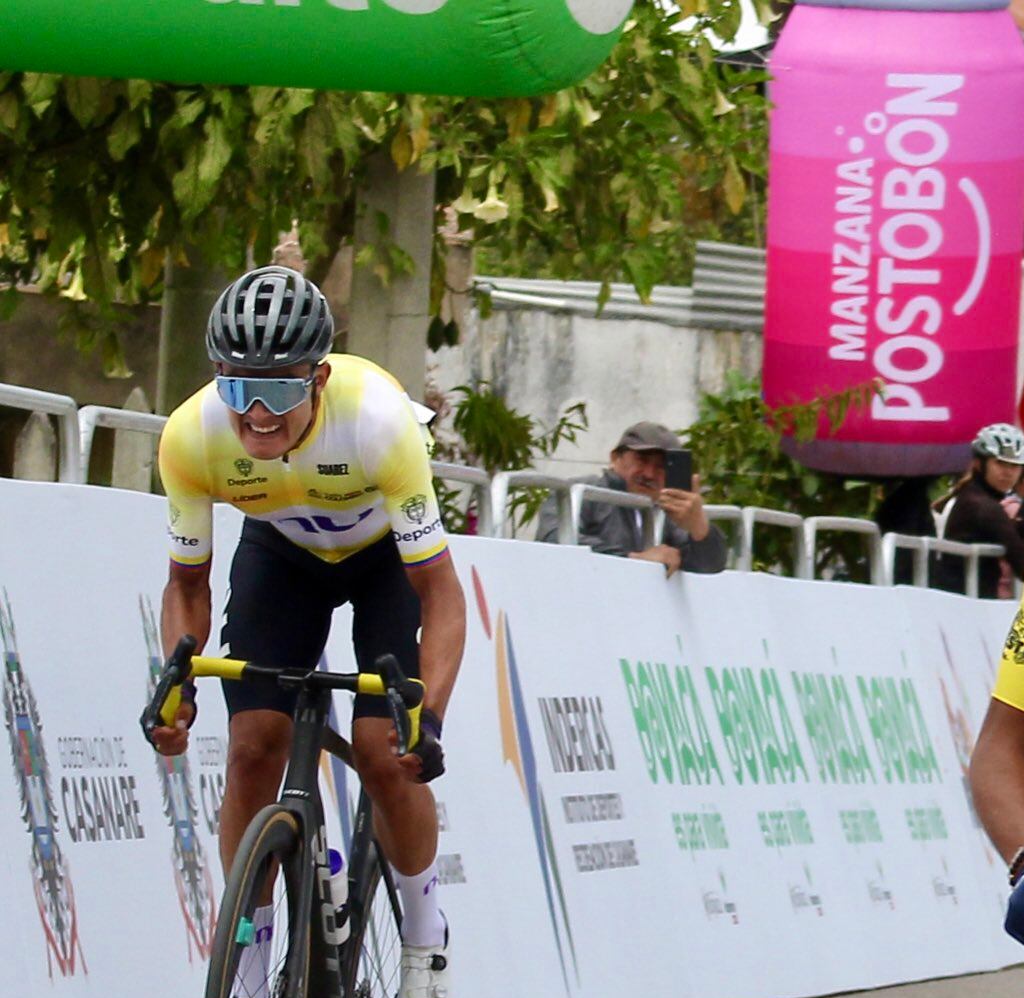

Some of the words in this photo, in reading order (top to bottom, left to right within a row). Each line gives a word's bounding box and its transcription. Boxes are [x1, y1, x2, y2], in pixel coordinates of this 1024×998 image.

[828, 157, 875, 362] MANZANA
[227, 477, 268, 486] Deporte
[61, 775, 145, 842] CASANARE
